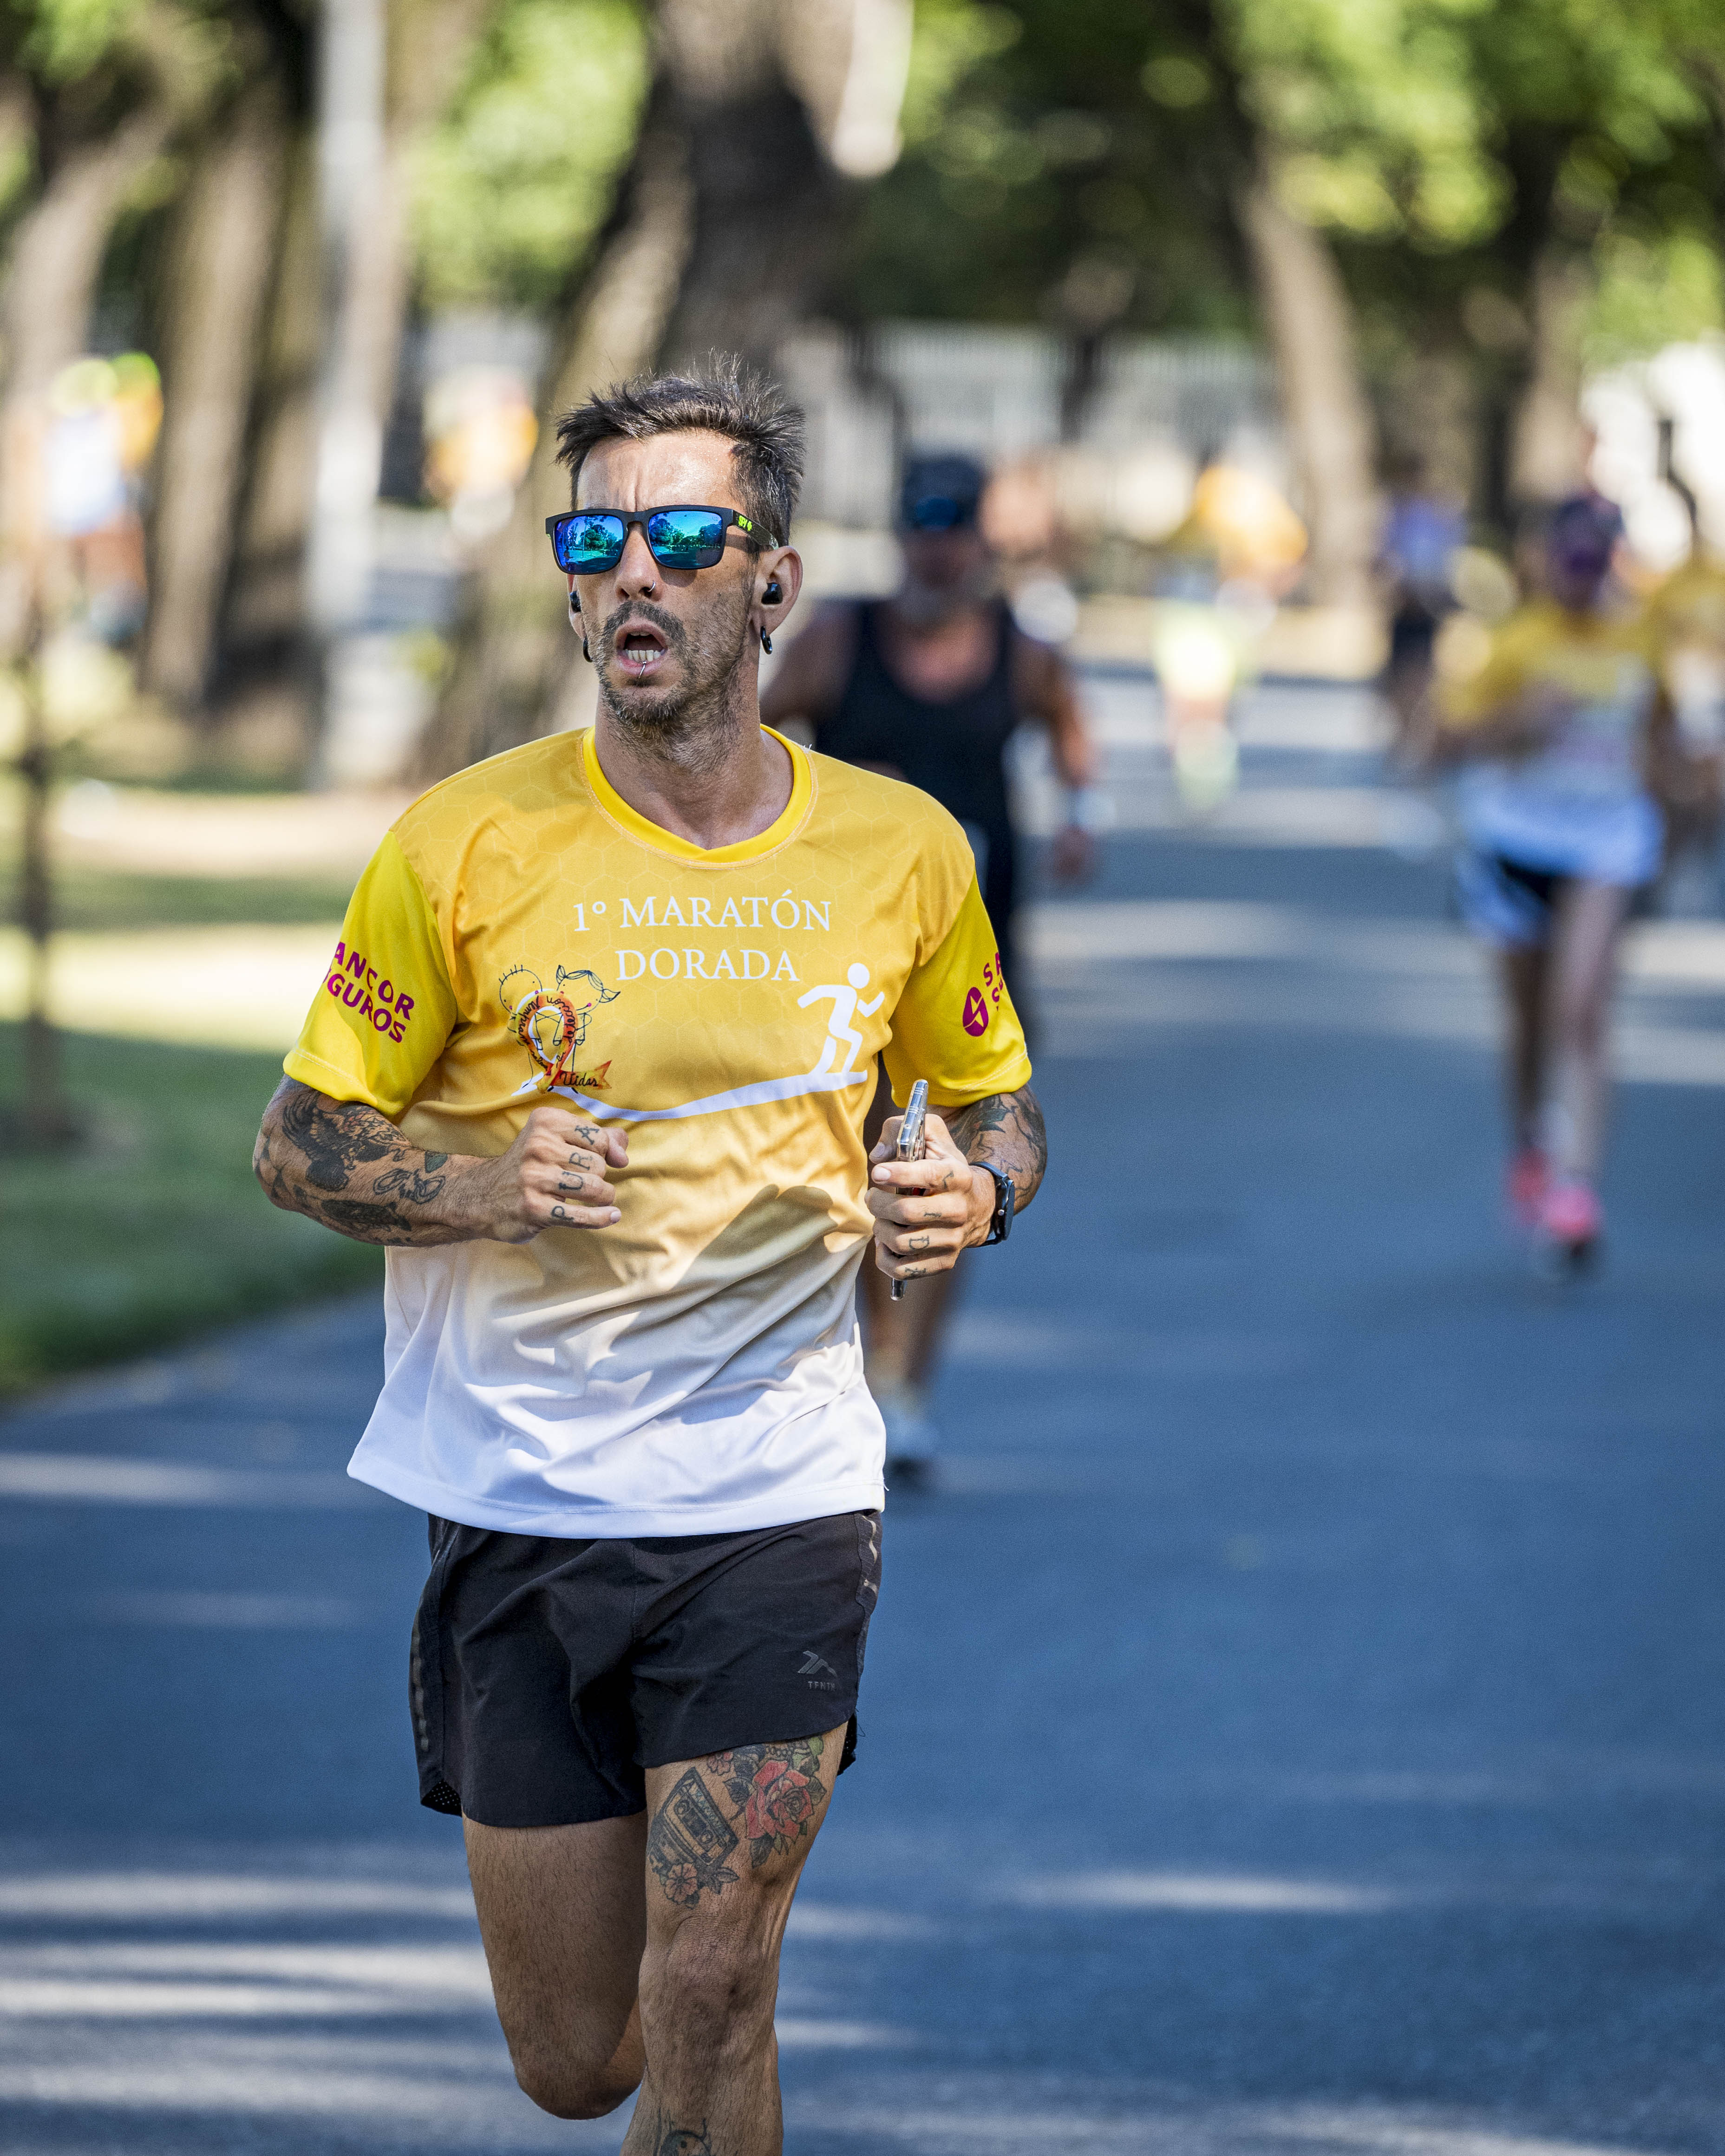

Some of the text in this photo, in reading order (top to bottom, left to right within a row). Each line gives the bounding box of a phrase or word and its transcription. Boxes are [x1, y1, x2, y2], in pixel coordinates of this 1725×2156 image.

[619, 889, 831, 931] MARATÓN
[615, 948, 800, 982] DORADA
[323, 968, 406, 1043] GUROS
